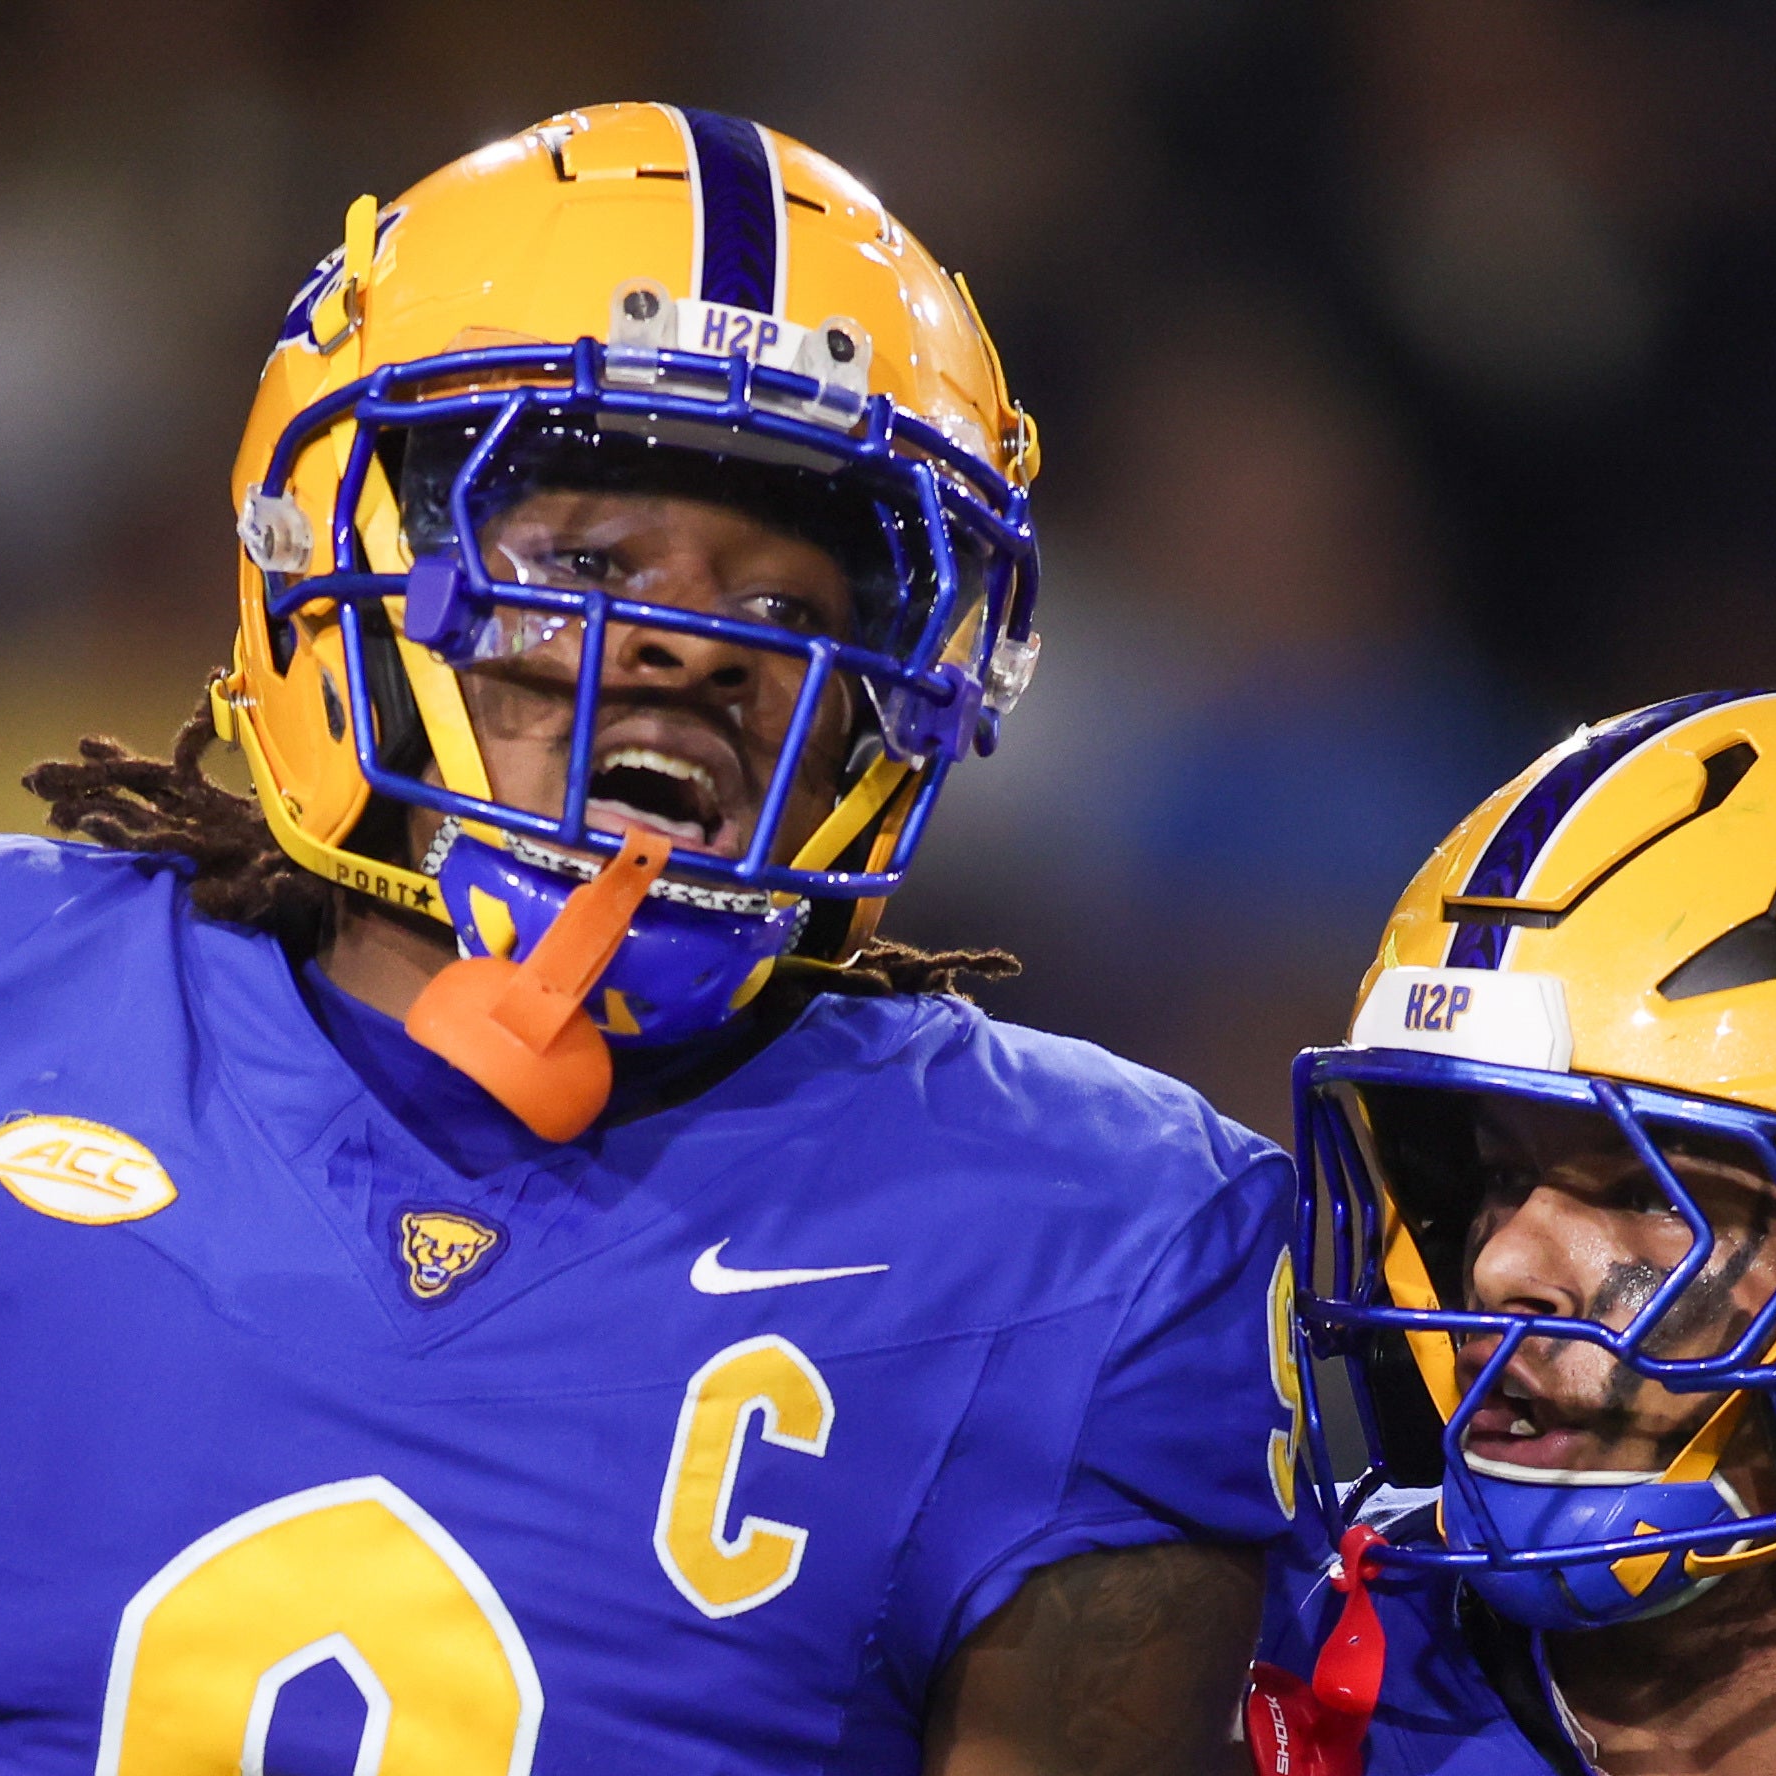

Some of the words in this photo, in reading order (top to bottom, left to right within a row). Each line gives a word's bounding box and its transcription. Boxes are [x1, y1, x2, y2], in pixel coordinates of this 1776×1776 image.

[702, 308, 779, 359] H2P
[1404, 983, 1473, 1032] H2P
[11, 1139, 152, 1193] ACC
[653, 1335, 835, 1618] C
[1265, 1694, 1290, 1776] SHOCK
